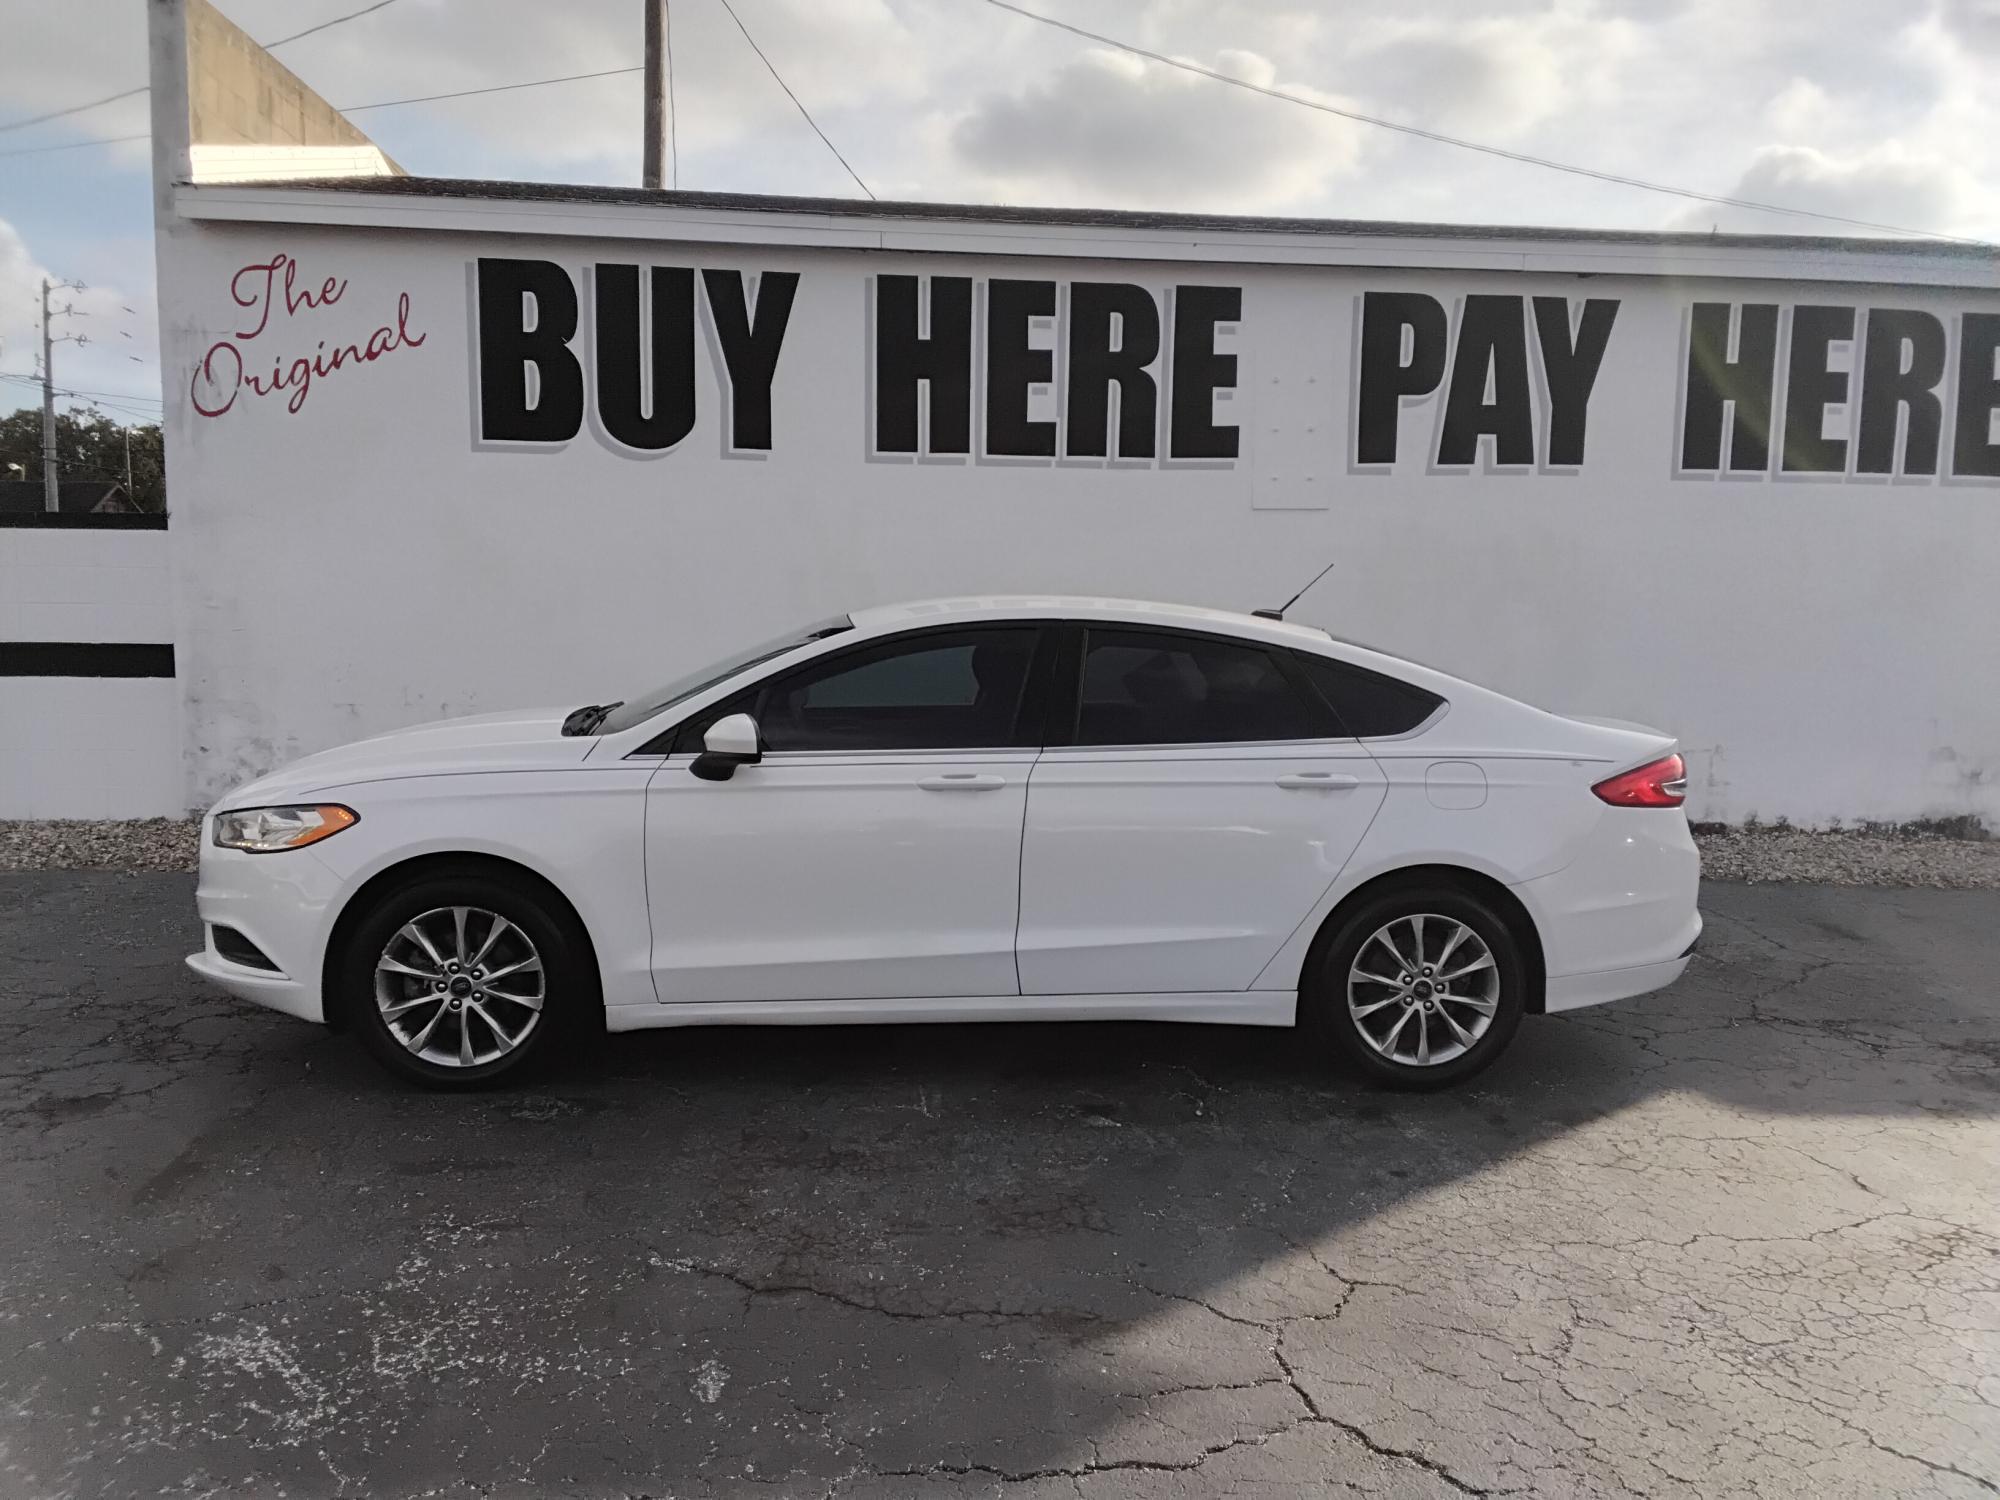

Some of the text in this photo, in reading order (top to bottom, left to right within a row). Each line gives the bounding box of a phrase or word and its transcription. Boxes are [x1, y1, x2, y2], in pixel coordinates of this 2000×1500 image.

[190, 293, 426, 417] Original
[230, 253, 348, 339] The
[477, 257, 2000, 477] BUY HERE PAY HERE
